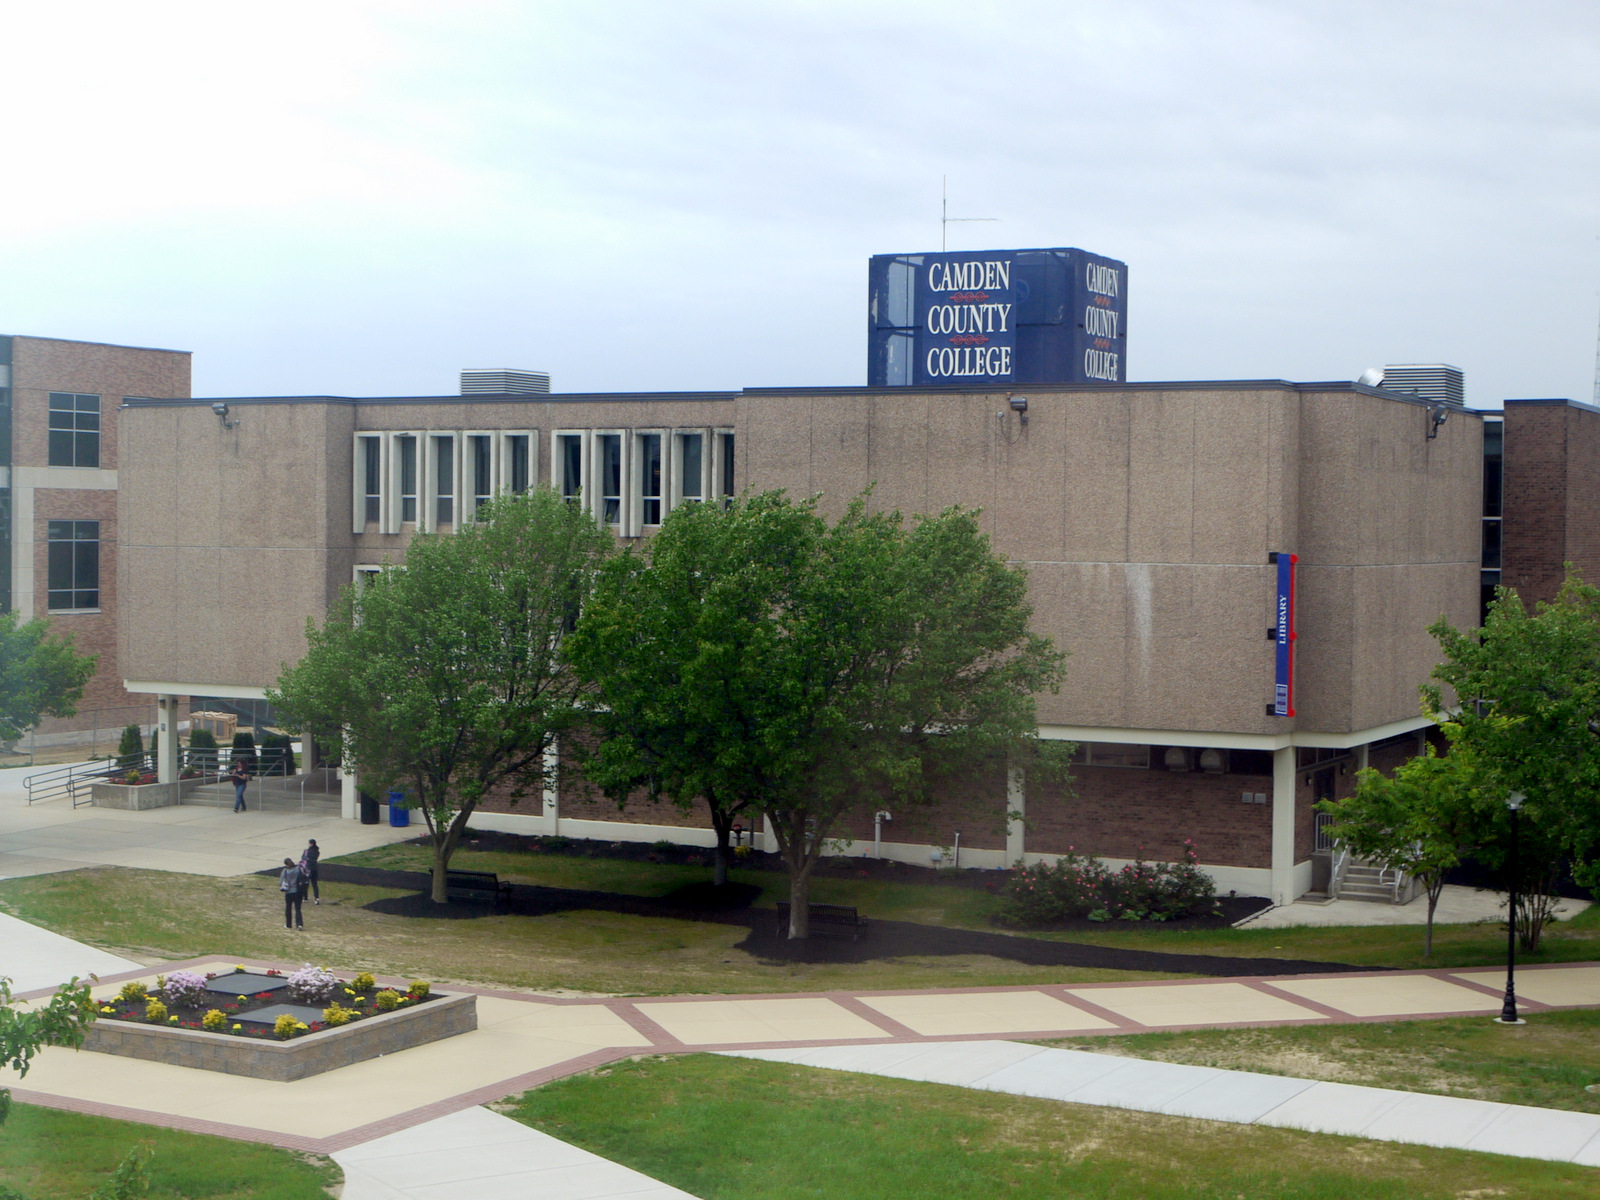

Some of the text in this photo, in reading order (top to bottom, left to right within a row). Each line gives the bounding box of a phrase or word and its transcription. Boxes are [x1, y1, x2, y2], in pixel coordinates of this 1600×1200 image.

[928, 261, 1011, 292] CAMDEN
[1086, 262, 1119, 298] CAMDEN
[927, 302, 1012, 335] COUNTY
[1085, 305, 1119, 339] COUNTY
[926, 346, 1012, 377] COLLEGE
[1084, 348, 1118, 382] COLLEGE
[1279, 594, 1287, 645] LIBRARY
